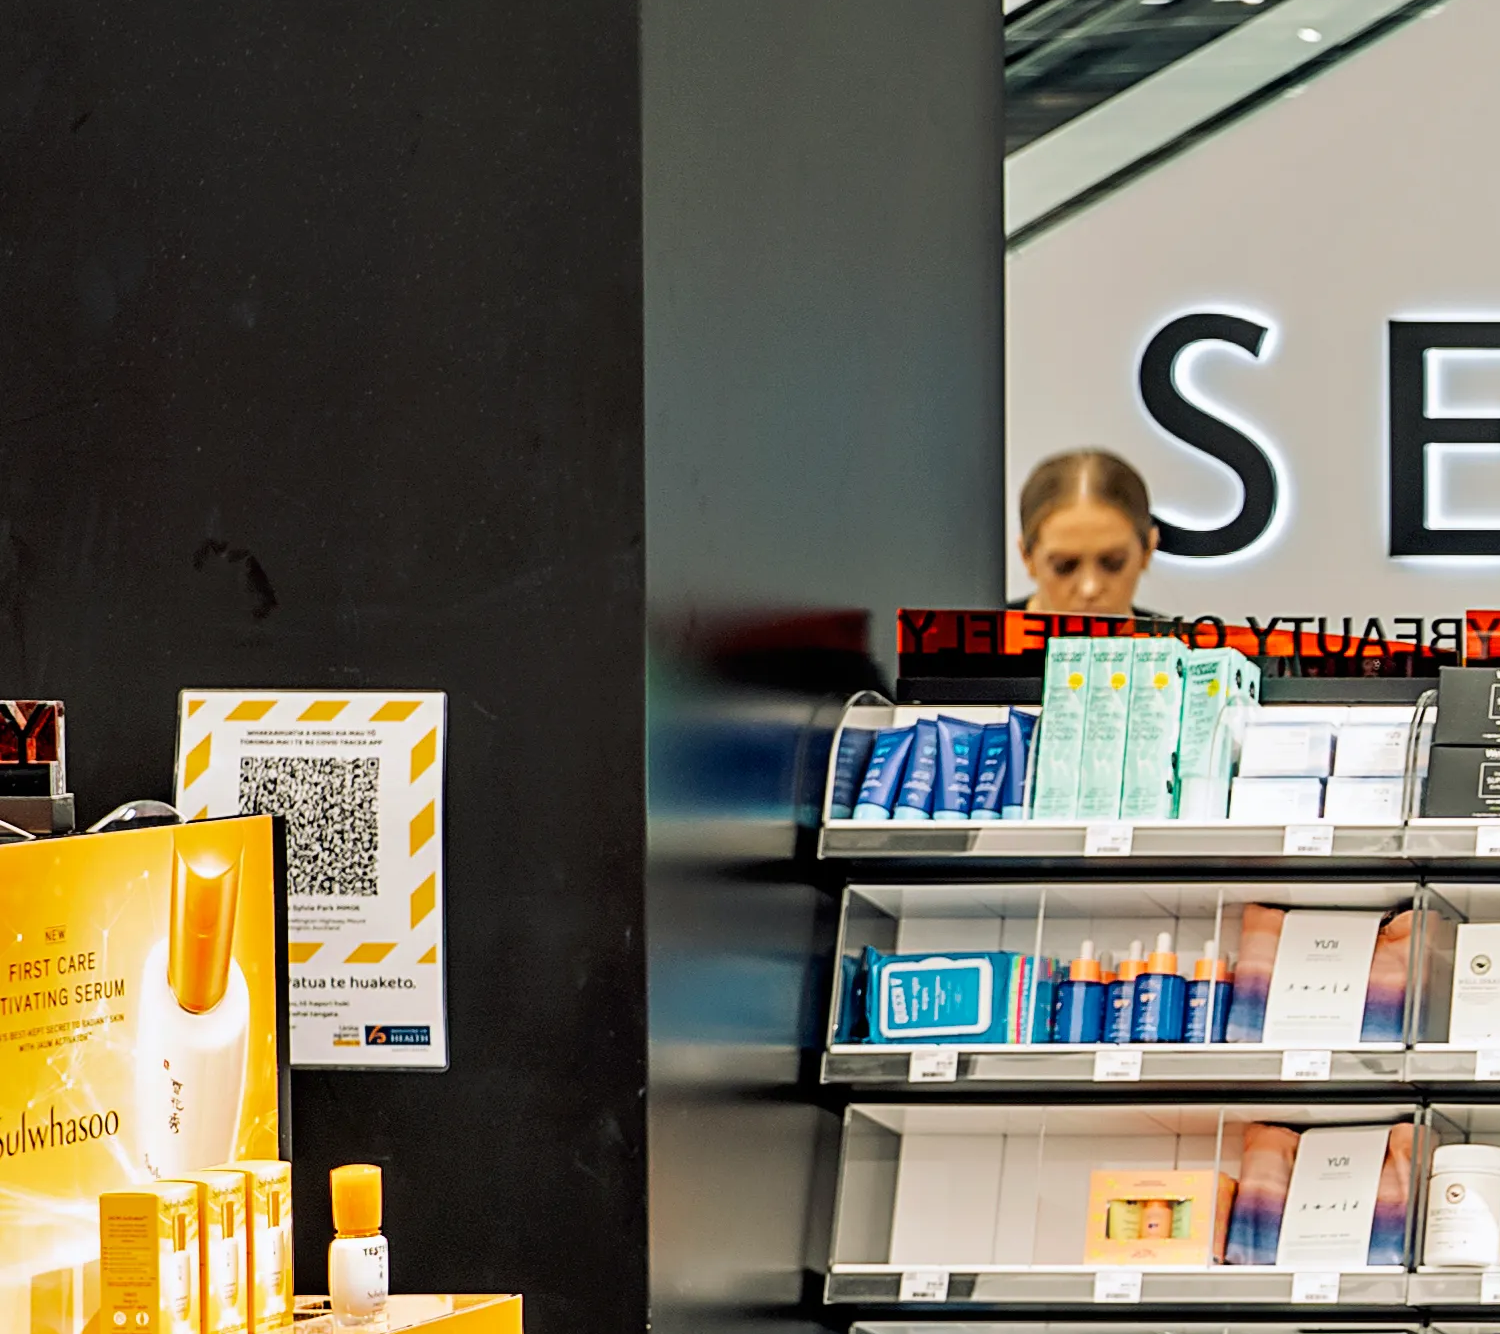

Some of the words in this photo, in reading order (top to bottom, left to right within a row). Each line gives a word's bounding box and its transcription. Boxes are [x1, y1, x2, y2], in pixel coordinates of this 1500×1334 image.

[45, 929, 66, 942] NEW
[9, 957, 51, 983] FIRST
[57, 951, 96, 975] CARE
[288, 976, 327, 989] atua
[330, 976, 346, 989] te
[0, 988, 69, 1016] TIVATING
[75, 979, 126, 1004] SERUM
